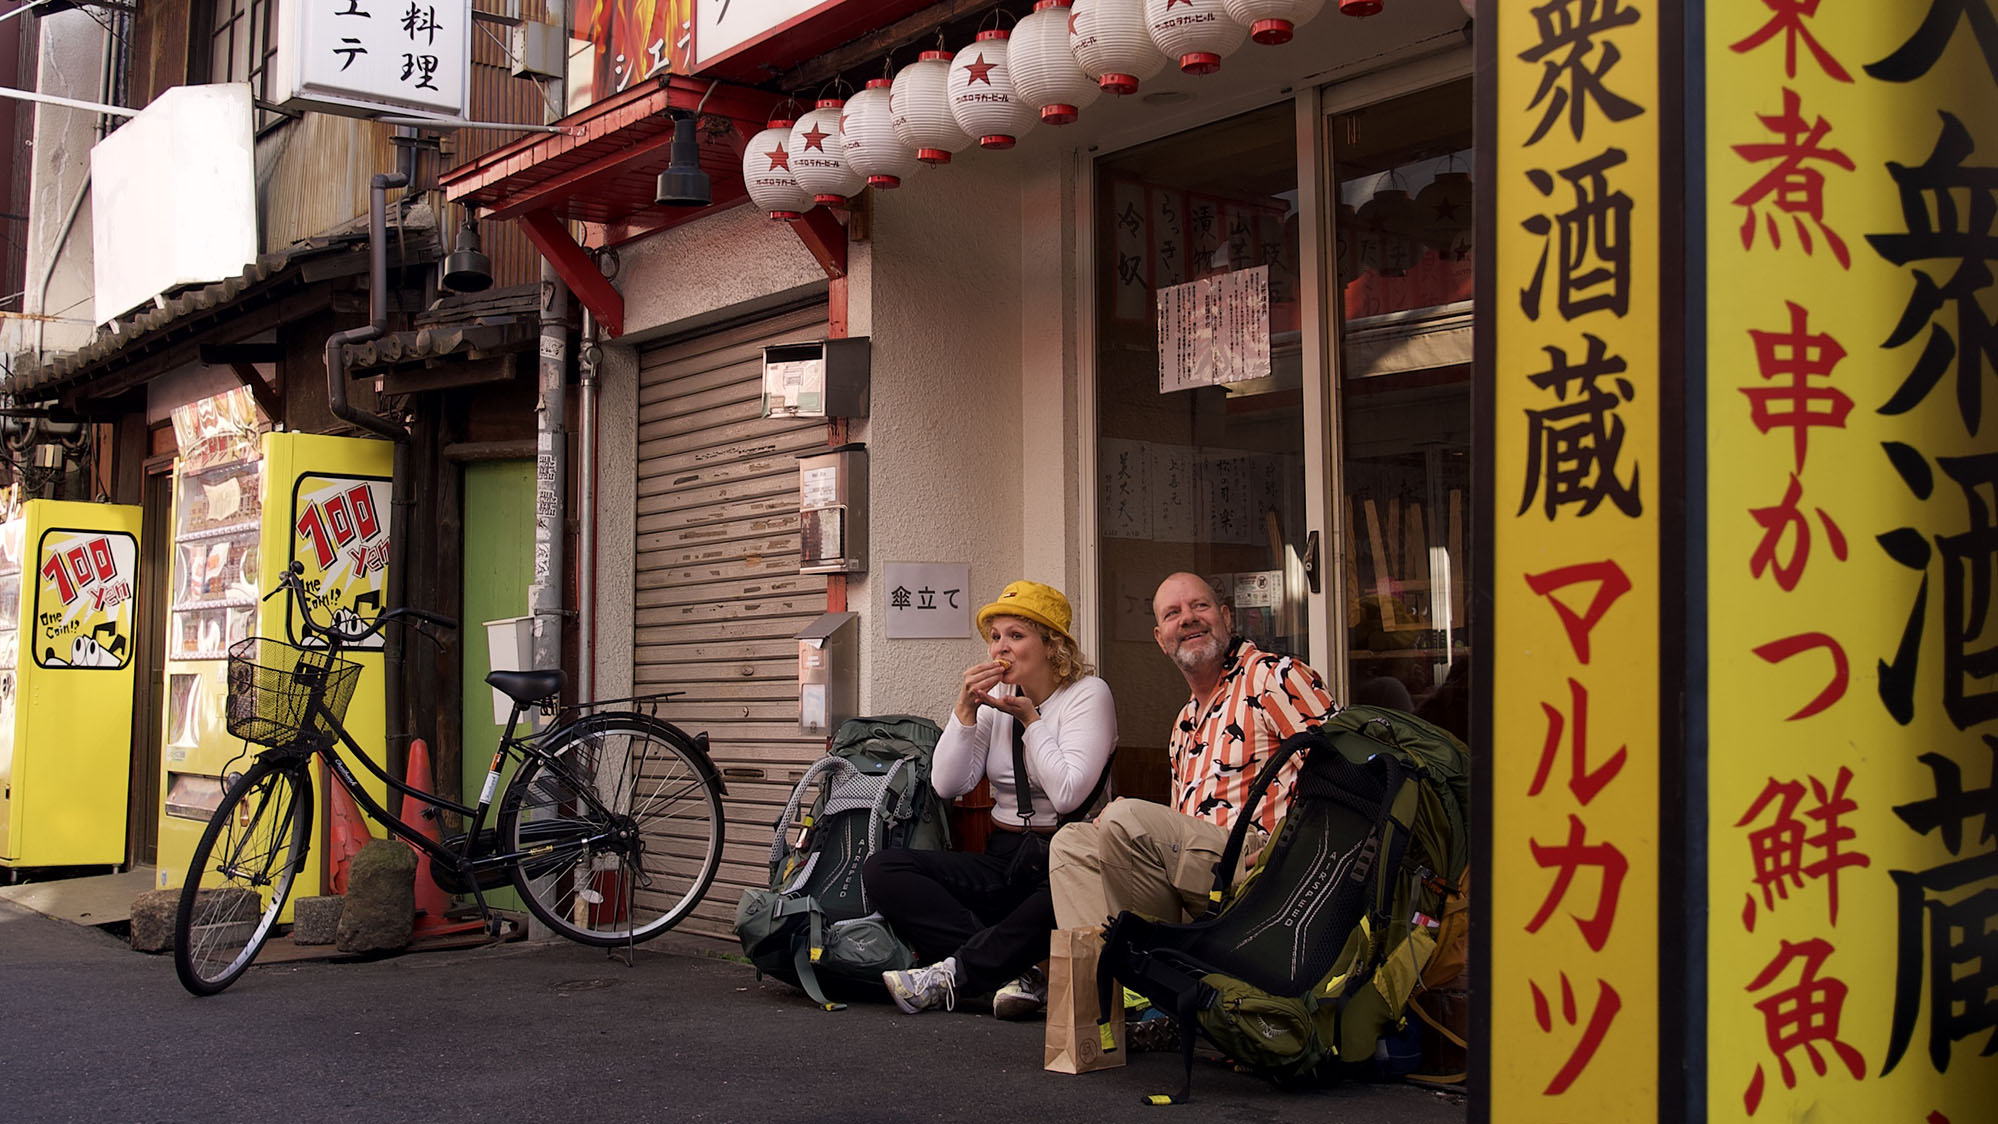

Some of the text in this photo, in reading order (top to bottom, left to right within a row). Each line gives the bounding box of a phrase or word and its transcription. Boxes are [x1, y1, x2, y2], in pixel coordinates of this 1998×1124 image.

[400, 1, 443, 92] 料理
[1118, 200, 1148, 289] 冷奴
[296, 482, 381, 572] 100
[1737, 299, 1856, 722] 串かつ
[41, 535, 118, 607] 100
[300, 579, 321, 593] ne
[891, 585, 960, 611] 傘立て
[1523, 558, 1632, 1096] マルカツ
[1284, 851, 1337, 927] AIRSPEED
[1733, 765, 1870, 1117] 鮮魚
